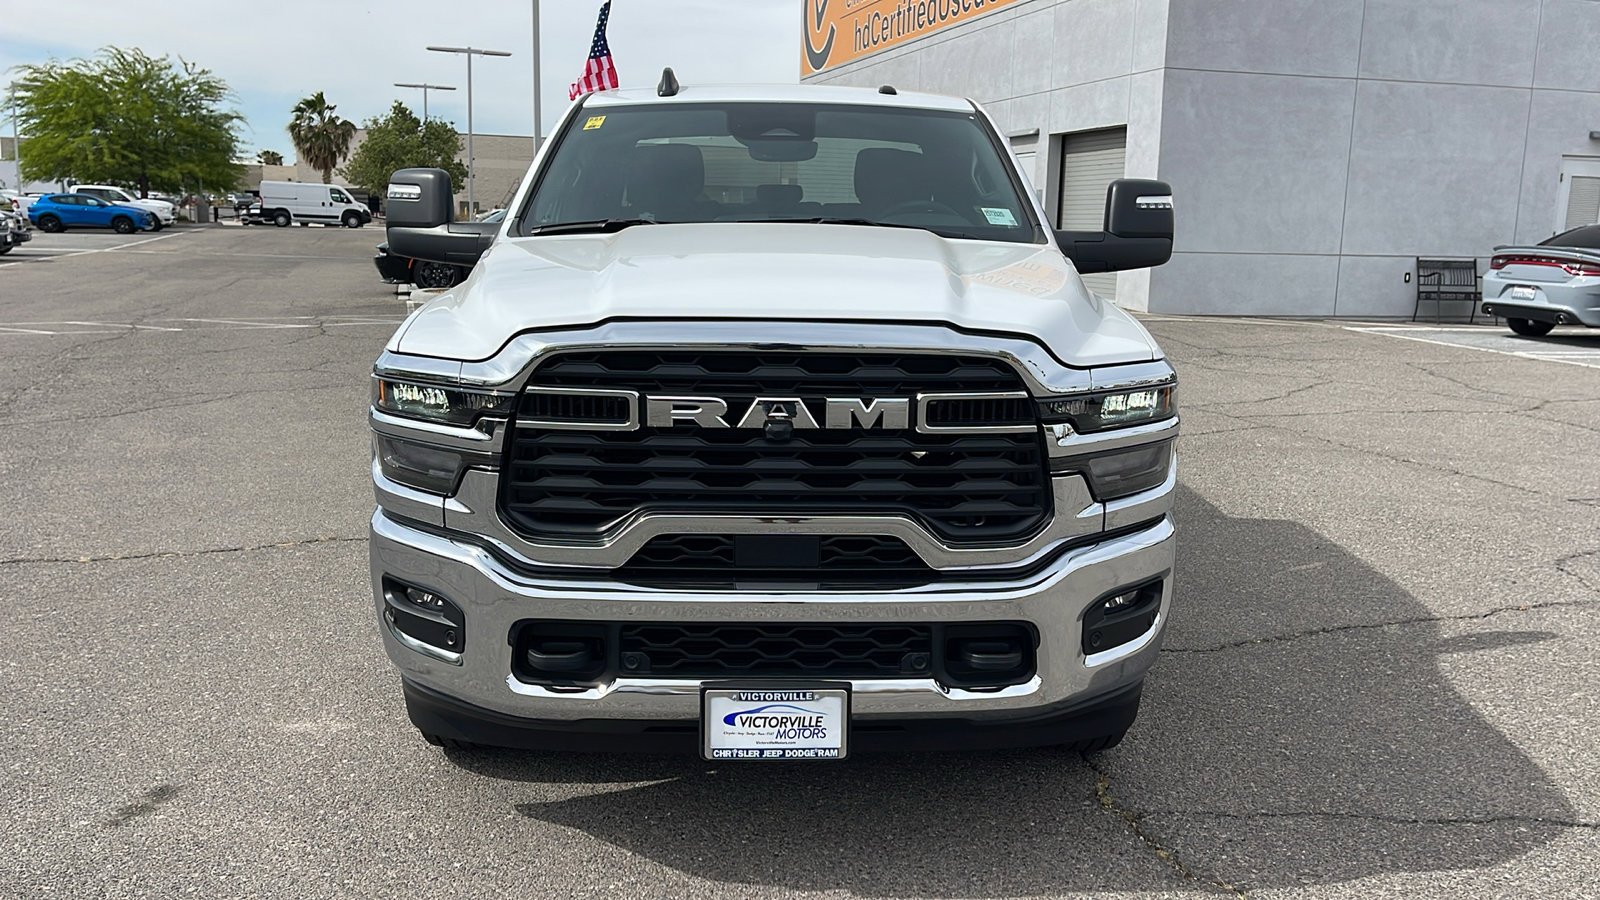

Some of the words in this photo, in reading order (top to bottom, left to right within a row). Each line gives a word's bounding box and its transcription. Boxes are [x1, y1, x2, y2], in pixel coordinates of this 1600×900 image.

[854, 0, 997, 52] hdCertifiedUs
[647, 395, 909, 429] RAM
[740, 692, 813, 701] VICTORVILLE
[739, 716, 824, 728] VICTORVILLE
[775, 727, 827, 739] MOTORS
[713, 750, 760, 758] CHRYSLER
[762, 750, 783, 758] JEEP
[785, 750, 816, 758] DODGE
[817, 750, 838, 758] RAM
